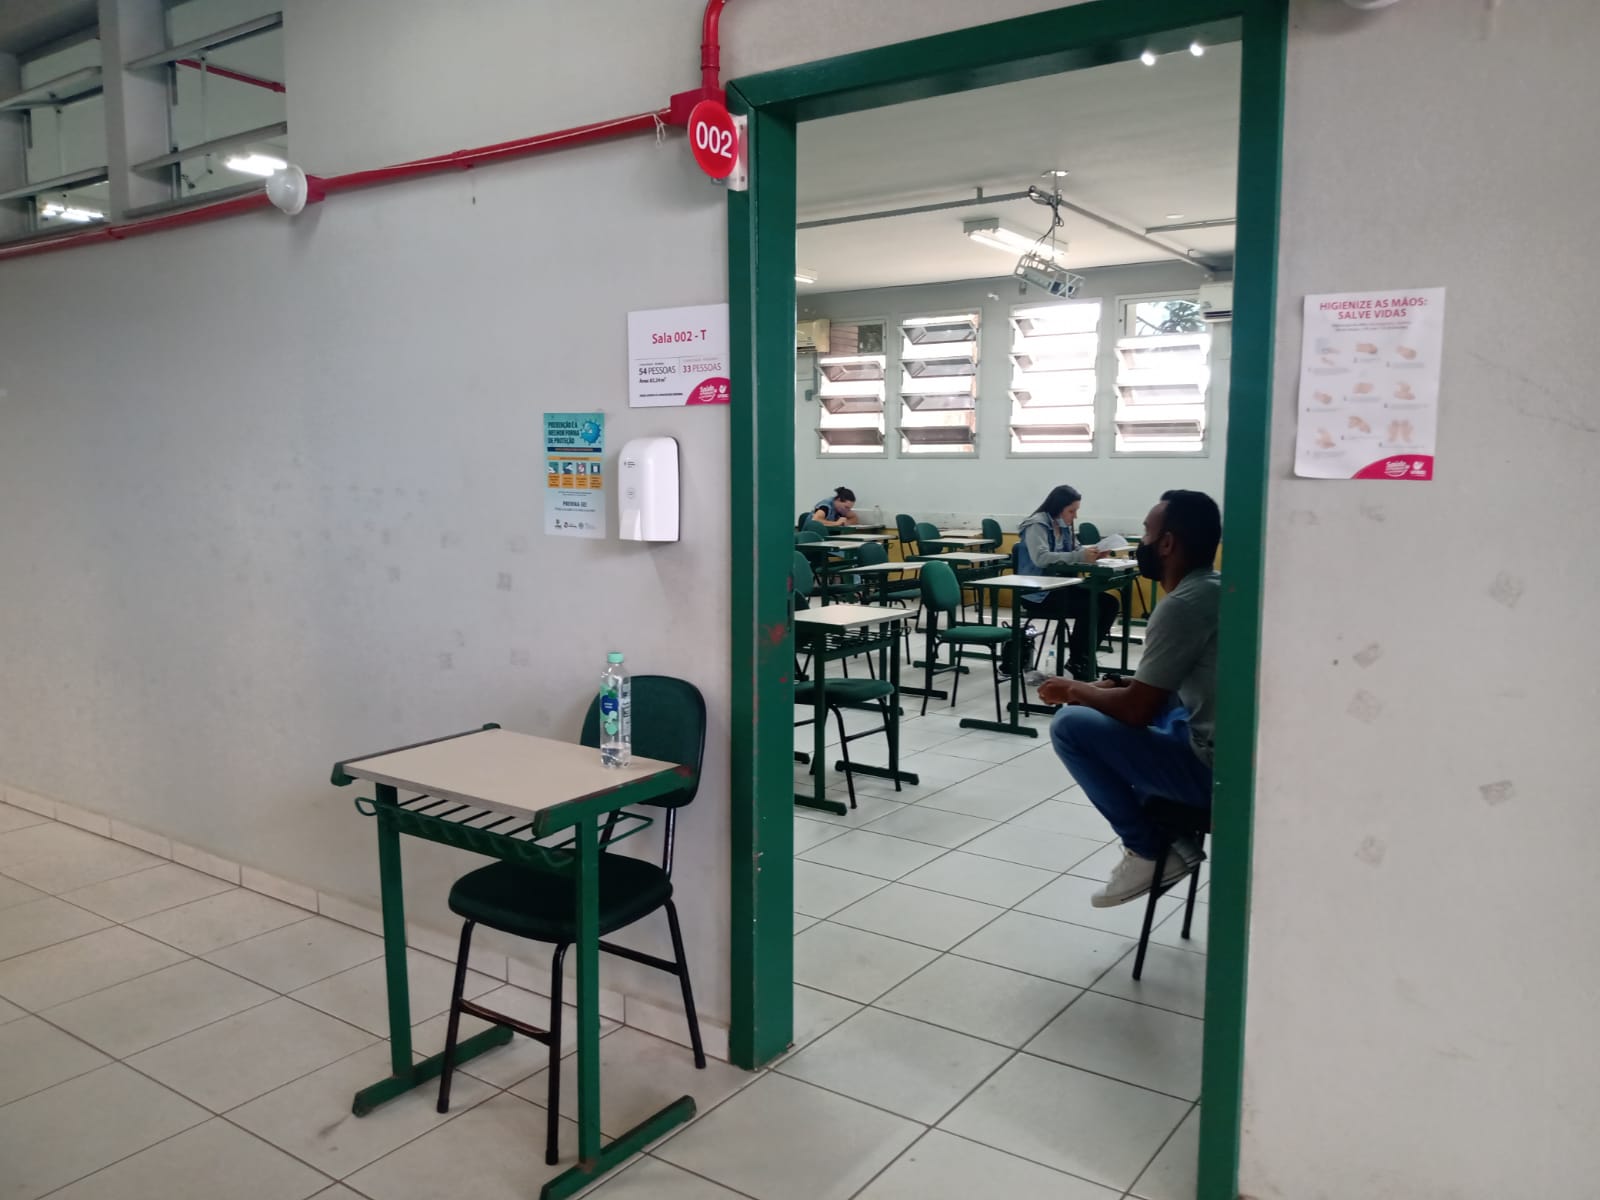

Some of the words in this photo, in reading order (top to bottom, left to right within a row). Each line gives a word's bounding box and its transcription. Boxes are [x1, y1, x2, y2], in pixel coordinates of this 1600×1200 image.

[696, 121, 733, 159] 002
[1320, 300, 1372, 310] HIGIENIZE
[1375, 299, 1389, 308] AS
[1391, 296, 1428, 307] MÃOS:
[1338, 310, 1371, 320] SALVE
[1375, 308, 1407, 319] VIDAS
[652, 332, 672, 344] Sala
[674, 331, 693, 343] 002
[700, 329, 707, 340] T
[638, 367, 647, 376] 54
[648, 365, 676, 375] PESSOAS
[682, 364, 691, 374] 33
[692, 362, 722, 372] PESSOAS
